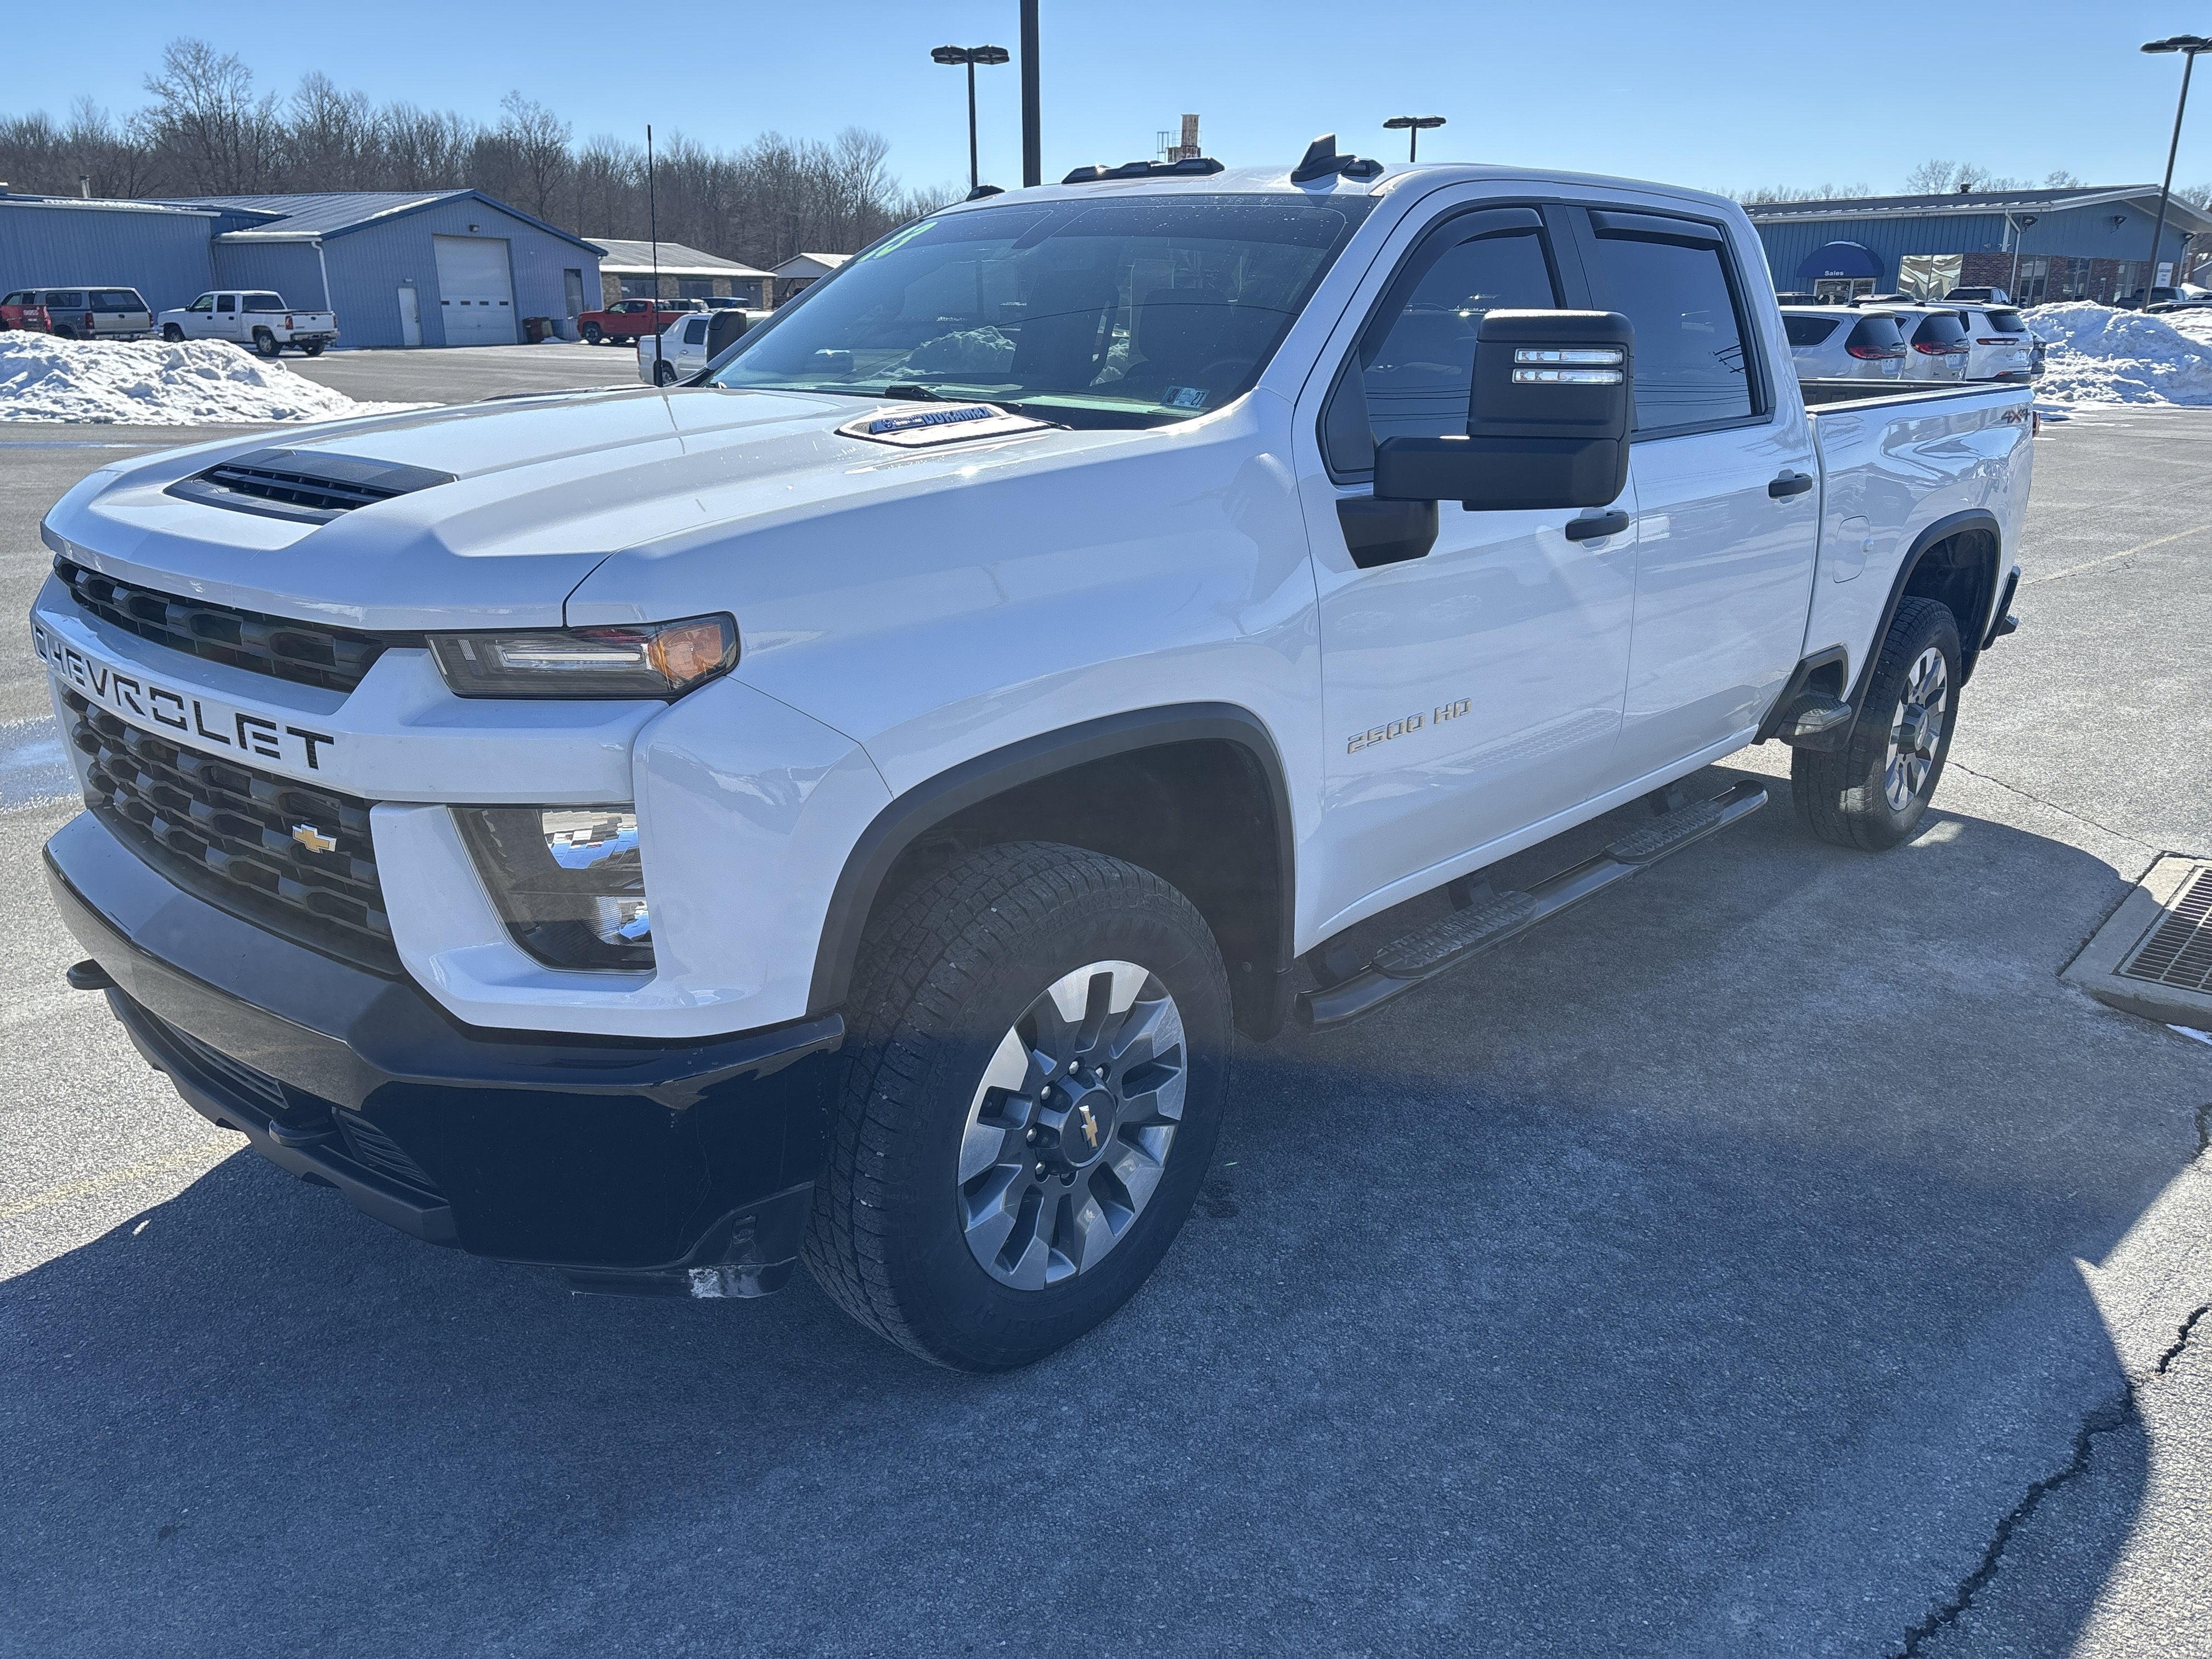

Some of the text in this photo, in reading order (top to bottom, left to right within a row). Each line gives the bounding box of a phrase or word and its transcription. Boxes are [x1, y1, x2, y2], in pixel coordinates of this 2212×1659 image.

[922, 407, 991, 425] DURAMAX
[1190, 391, 1205, 406] 27
[36, 625, 335, 770] CHEVROLET
[1347, 697, 1471, 754] 2500 HD
